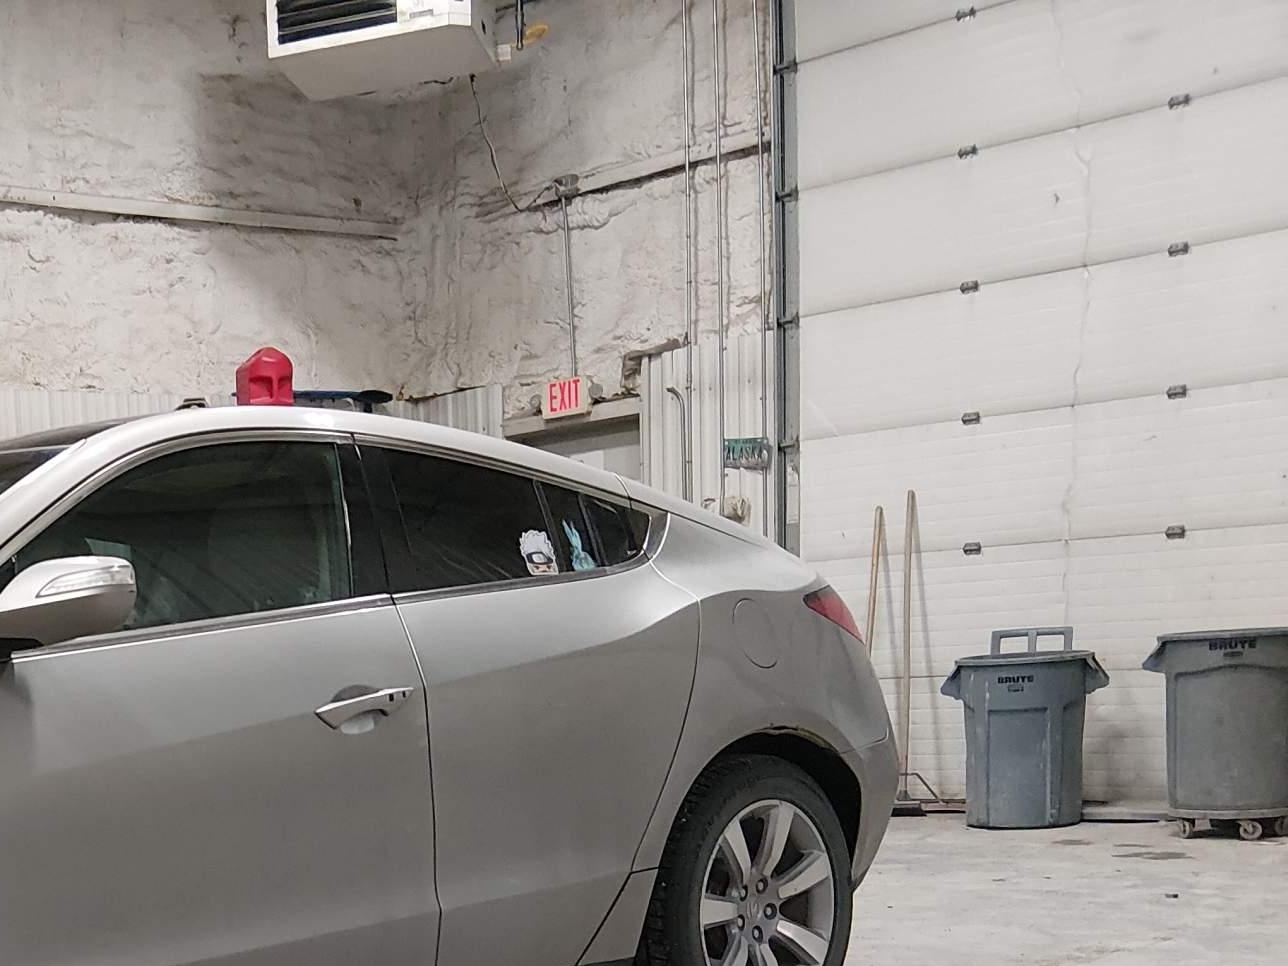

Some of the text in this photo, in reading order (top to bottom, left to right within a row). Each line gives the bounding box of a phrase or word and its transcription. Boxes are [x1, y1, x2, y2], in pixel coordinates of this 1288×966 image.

[549, 379, 580, 412] EXIT
[726, 445, 763, 461] ALASKA
[1208, 637, 1257, 651] BRUTE
[997, 675, 1034, 684] BRUTE
